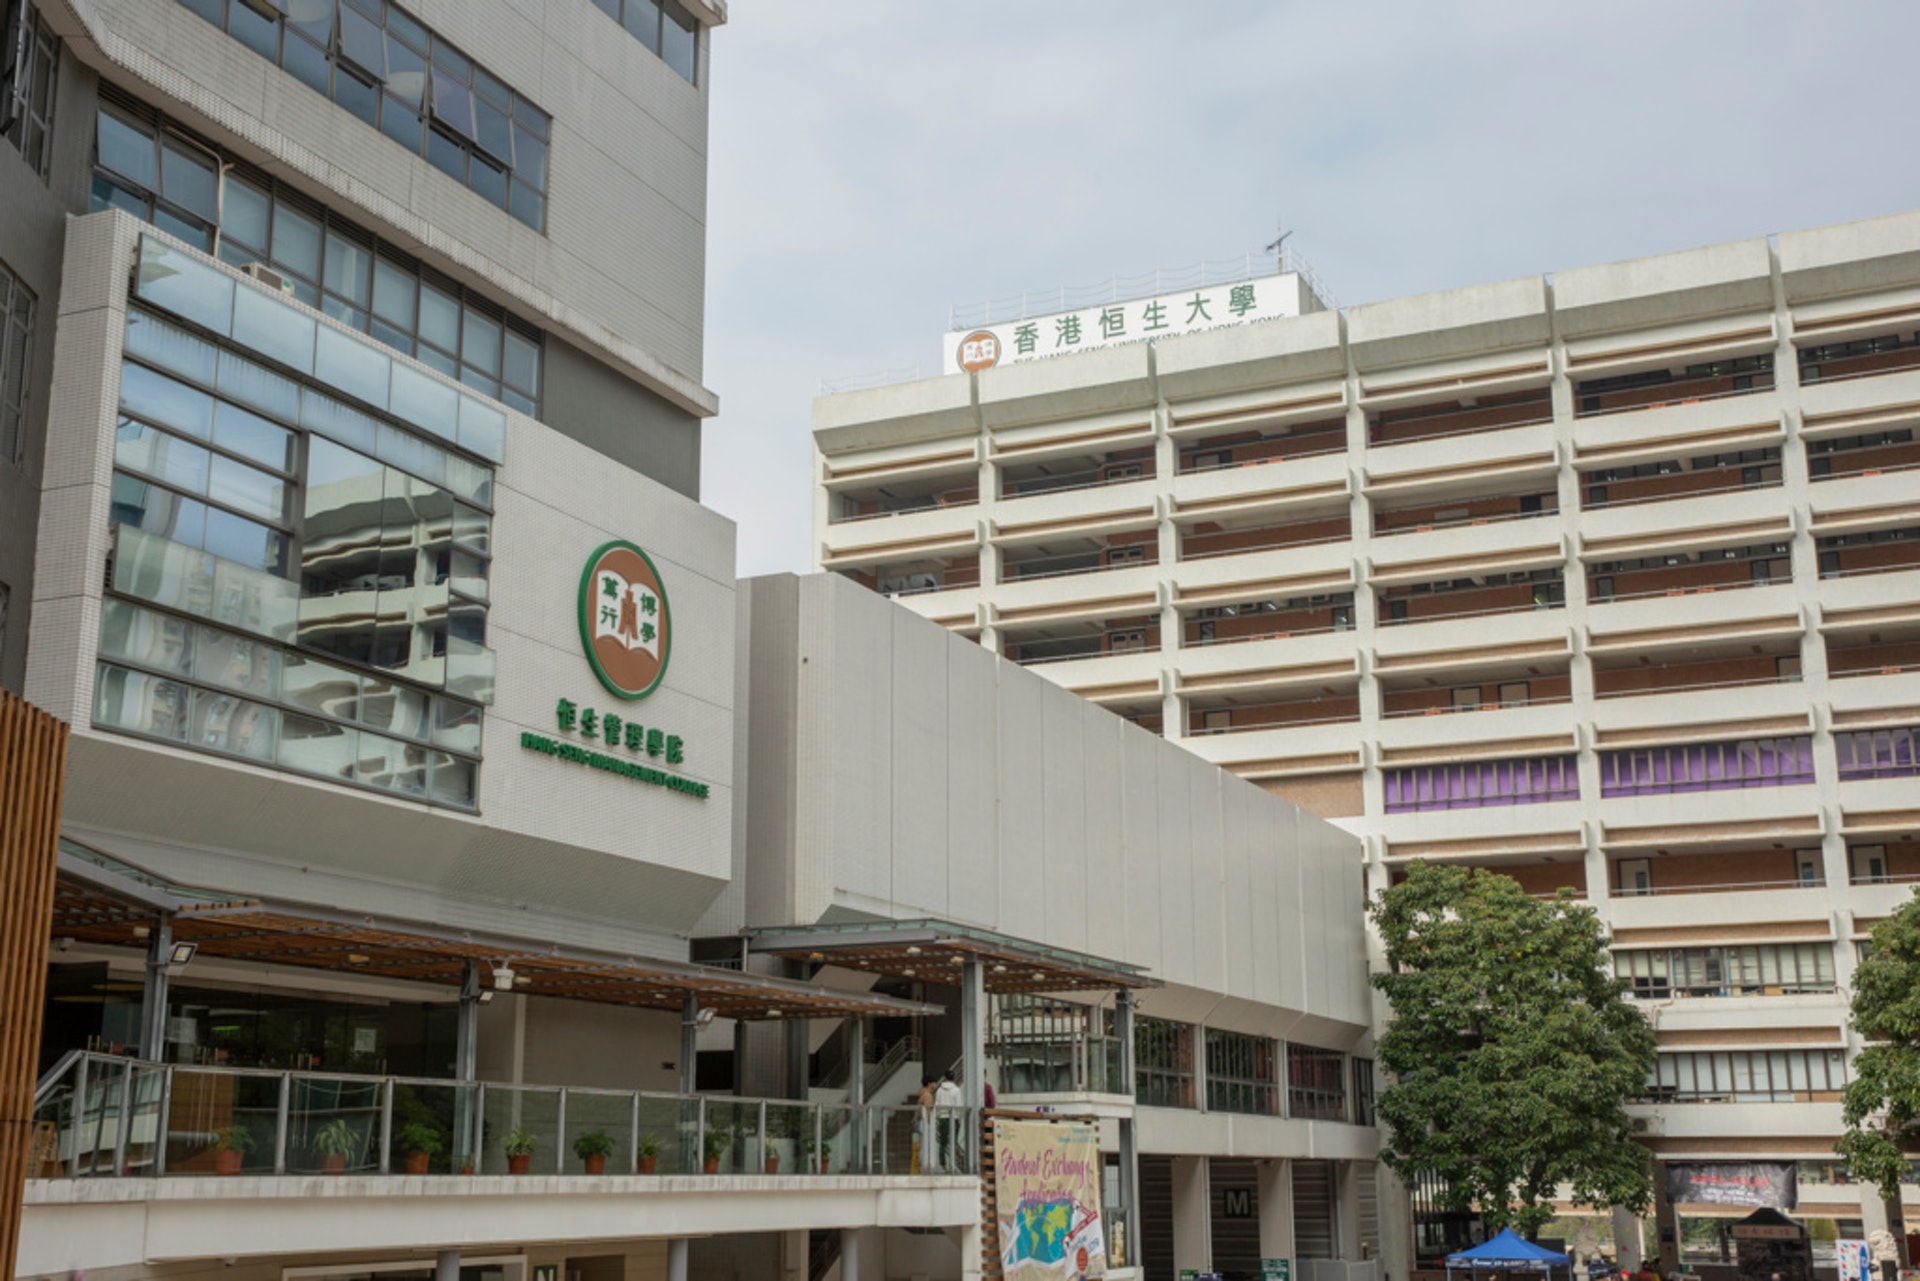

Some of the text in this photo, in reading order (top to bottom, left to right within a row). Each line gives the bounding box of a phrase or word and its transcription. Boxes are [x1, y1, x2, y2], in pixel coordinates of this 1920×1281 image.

[1013, 284, 1257, 355] 香港恒生大學
[1000, 1147, 1042, 1183] Student
[1226, 1191, 1248, 1215] M
